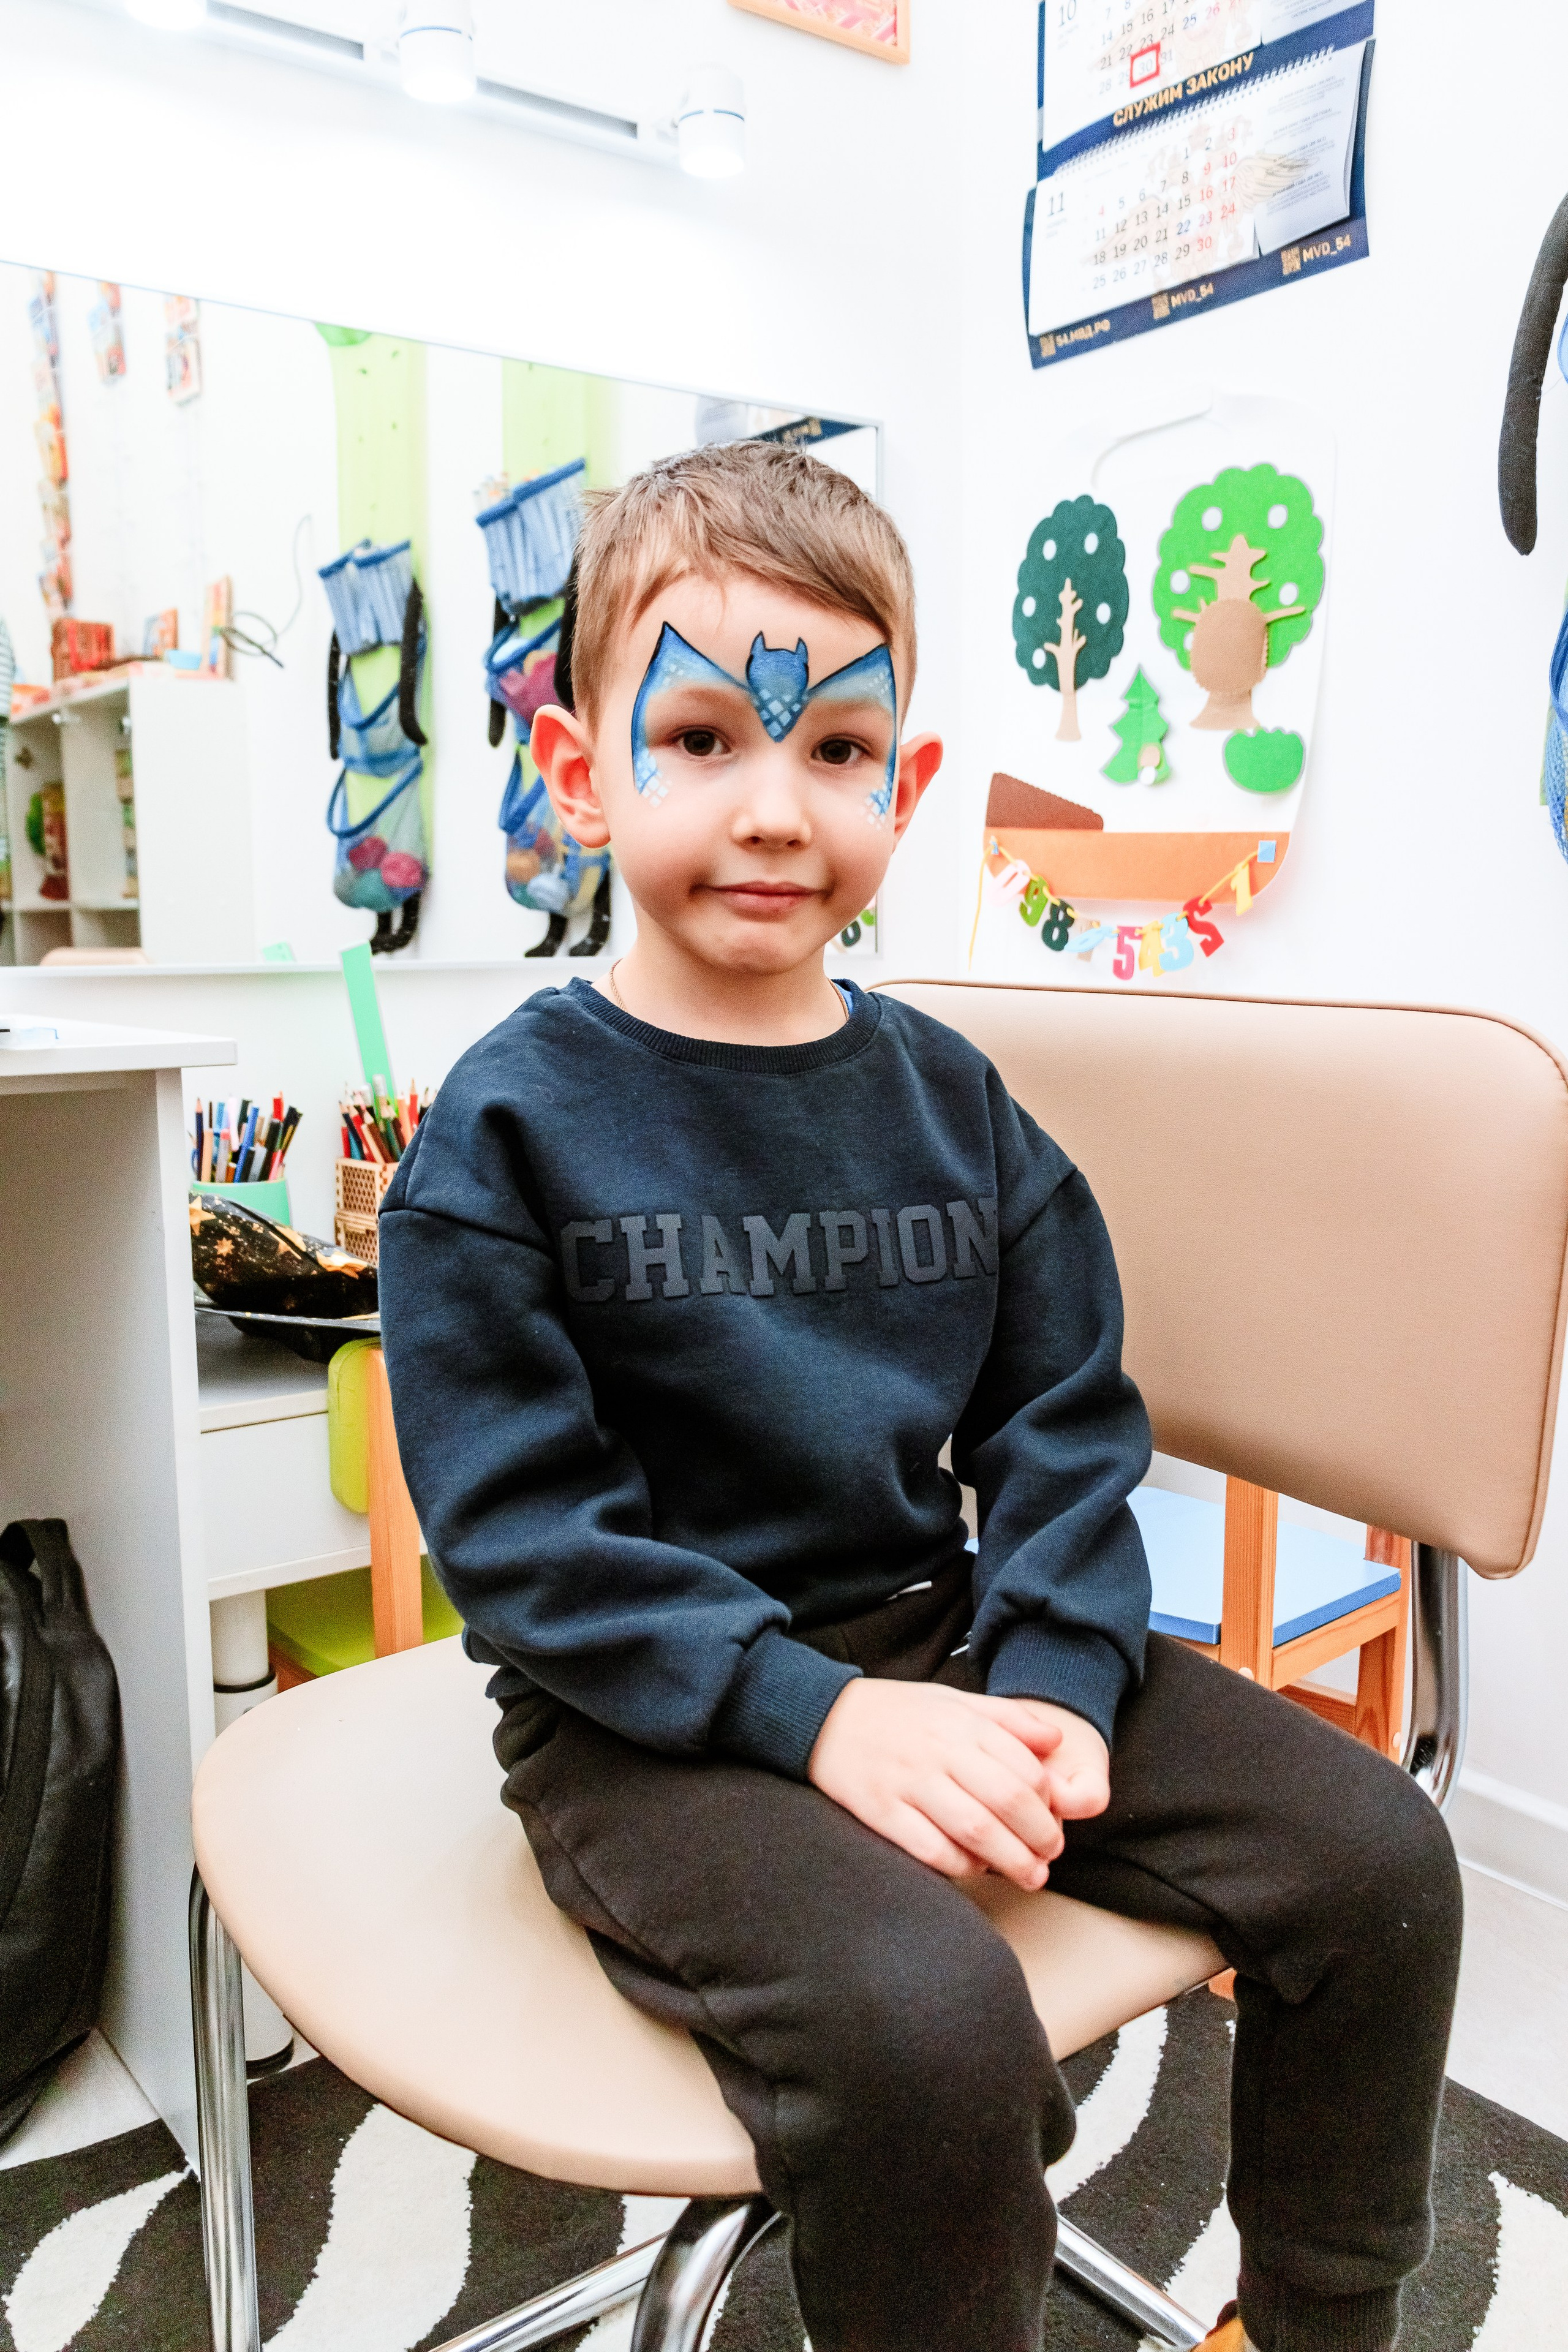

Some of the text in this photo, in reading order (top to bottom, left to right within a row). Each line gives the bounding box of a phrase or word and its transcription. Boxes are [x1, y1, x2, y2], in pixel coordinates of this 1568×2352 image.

[1058, 0, 1076, 28] 10
[1101, 31, 1112, 46] 14
[1121, 21, 1133, 36] 15
[1141, 9, 1154, 25] 16
[1101, 55, 1112, 70] 21
[1119, 43, 1133, 61] 22
[1140, 34, 1153, 50] 23
[1160, 23, 1175, 40] 24
[1182, 13, 1197, 30] 25
[1205, 2, 1221, 19] 26
[1105, 7, 1111, 20] 7
[1099, 78, 1112, 96] 28
[1139, 59, 1153, 75] 30
[1160, 49, 1173, 65] 31
[1114, 53, 1254, 126] СЛУЖИМ ЗАКОНУ
[1184, 128, 1235, 159] 1 2 3
[1118, 196, 1125, 209] 5
[1139, 188, 1146, 202] 6
[1161, 179, 1167, 193] 7
[1182, 170, 1189, 184] 8
[1203, 162, 1212, 176] 9
[1223, 151, 1237, 168] 10
[1047, 191, 1065, 217] 11
[1095, 176, 1237, 242] 11 12 13 14 15 16 17
[1093, 202, 1236, 266] 18 19 20 21 22 23 24
[1303, 234, 1352, 262] MVD_54
[1093, 235, 1212, 290] 25 26 27 28 29 30
[1172, 282, 1214, 307] MVD_54
[560, 1197, 998, 1303] CHAMPION
